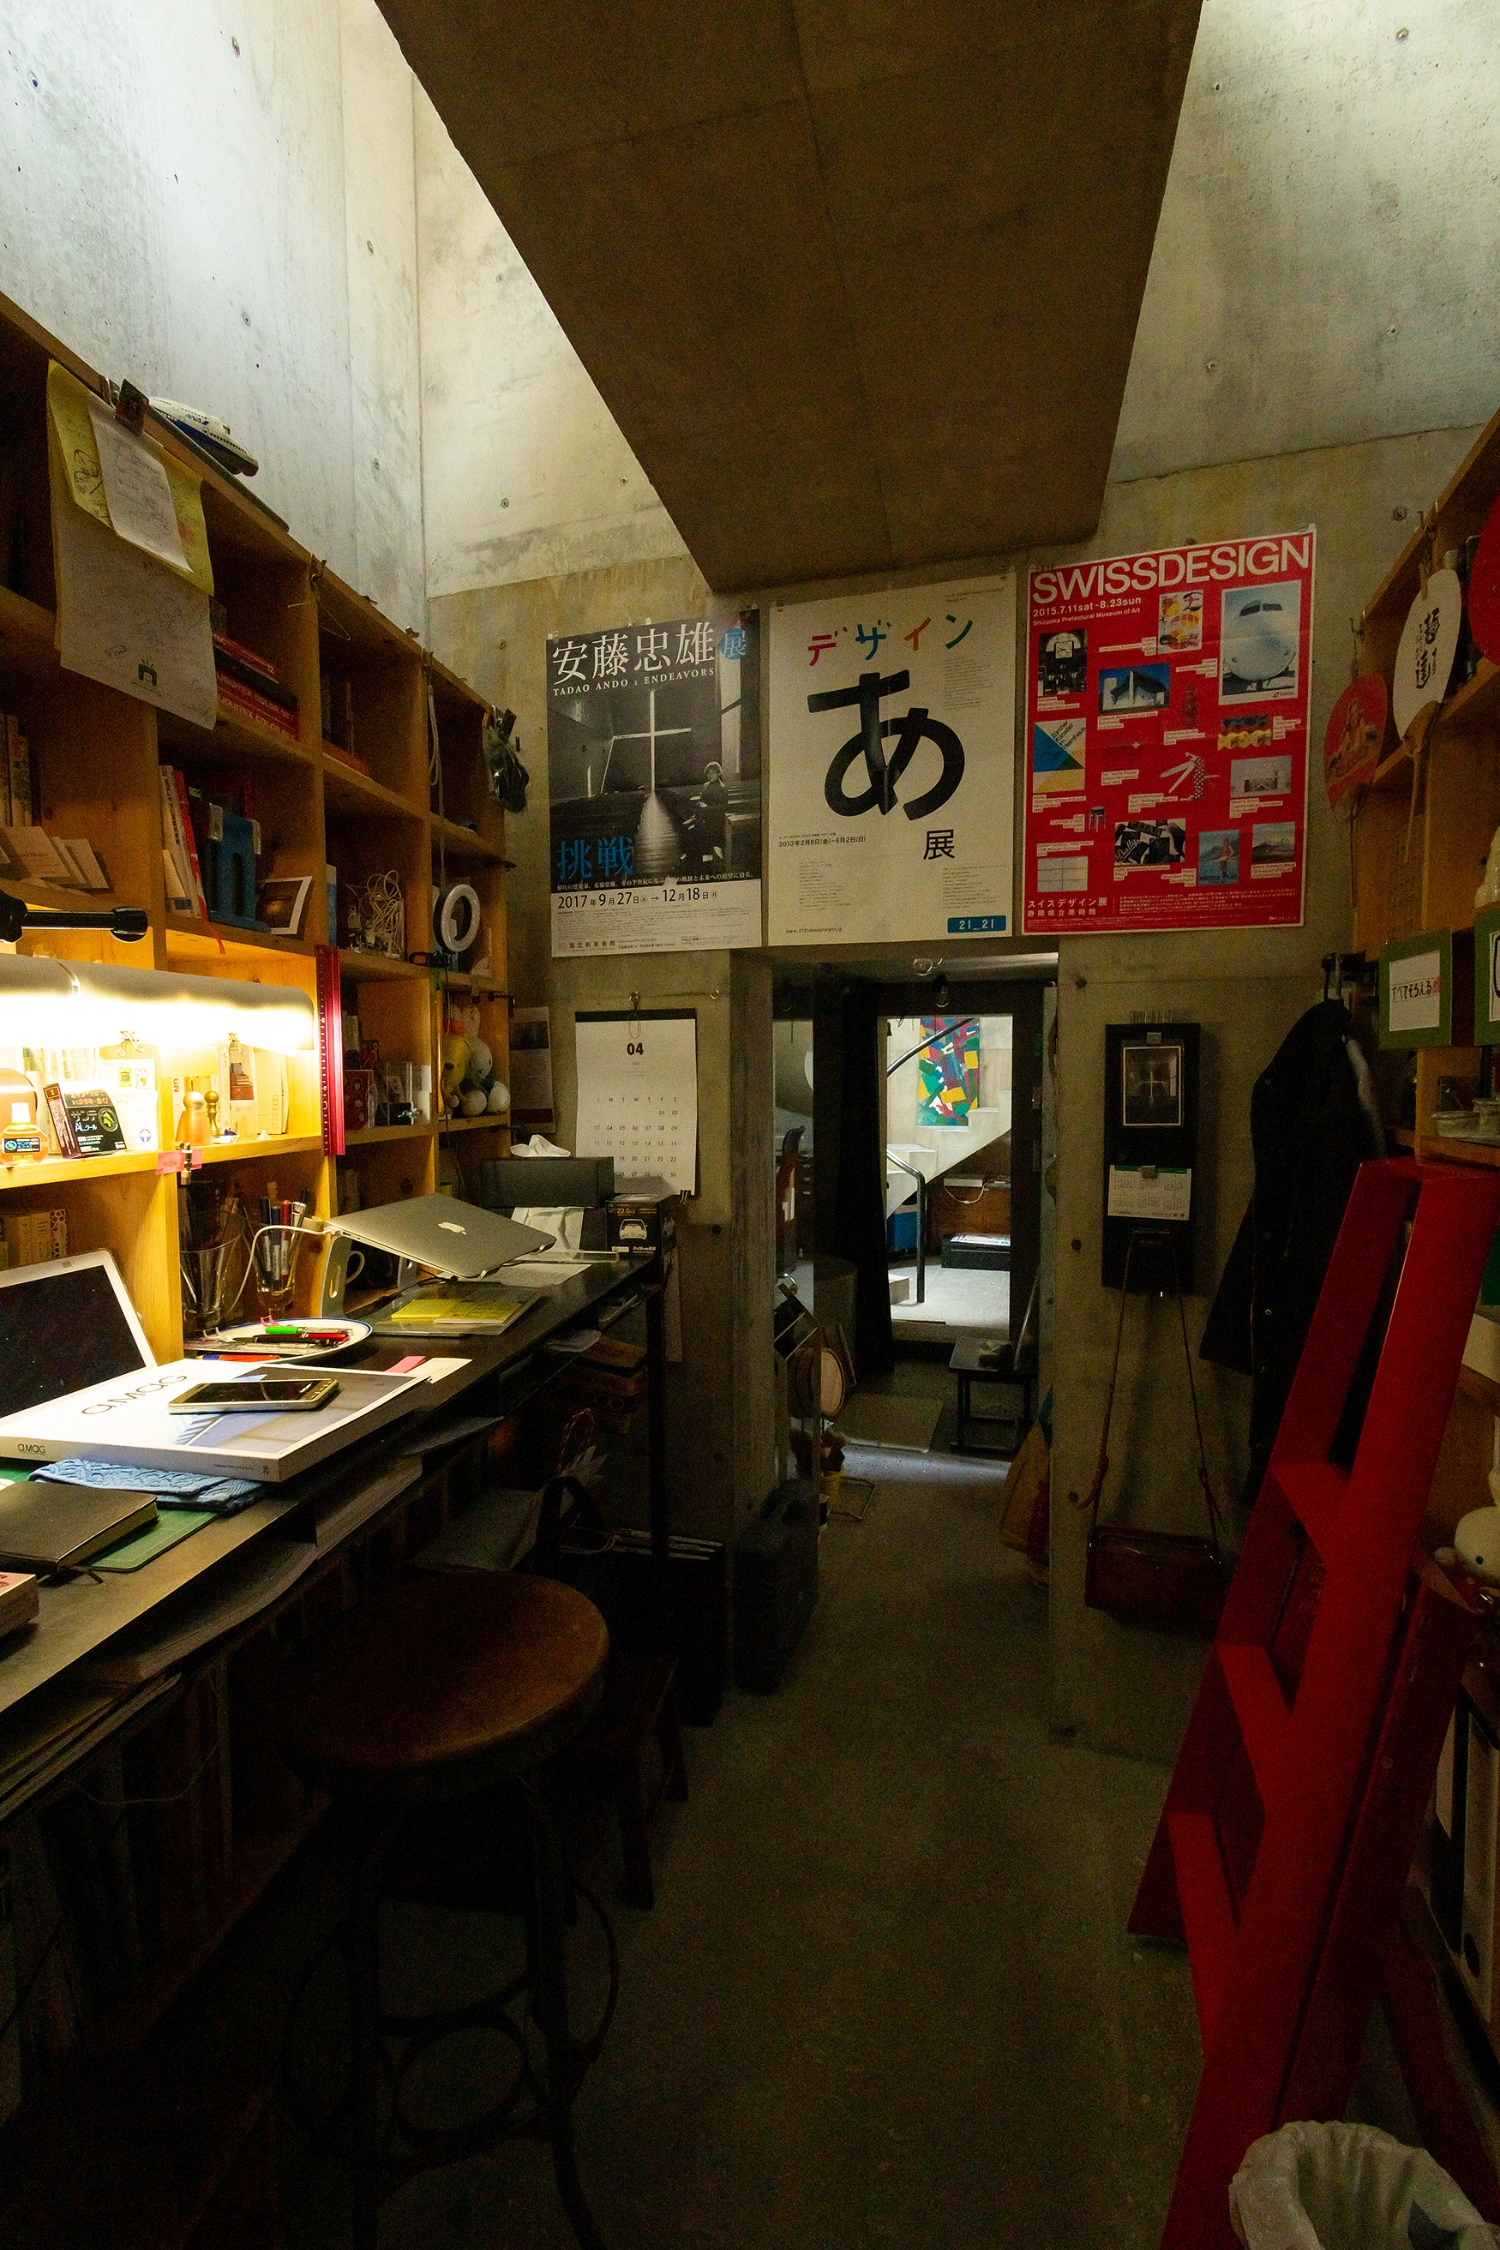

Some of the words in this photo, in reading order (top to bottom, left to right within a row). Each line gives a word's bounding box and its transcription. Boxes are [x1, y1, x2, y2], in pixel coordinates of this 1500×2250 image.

[185, 413, 202, 424] ANA
[1032, 537, 1310, 605] SWISSDESIGN
[1033, 617, 1061, 626] Shizuoka
[1062, 613, 1095, 623] Prefectural
[1096, 610, 1123, 619] Museum
[807, 614, 973, 667] デザイン
[553, 684, 590, 697] TADAO
[595, 679, 629, 691] ANDO
[644, 667, 715, 685] ENDEAVORS
[807, 669, 966, 821] あ
[557, 836, 634, 881] 挑戦
[923, 829, 956, 861] 展
[1027, 897, 1108, 909] スイスデザイン展
[958, 918, 995, 930] 21_21
[626, 1042, 644, 1056] 04
